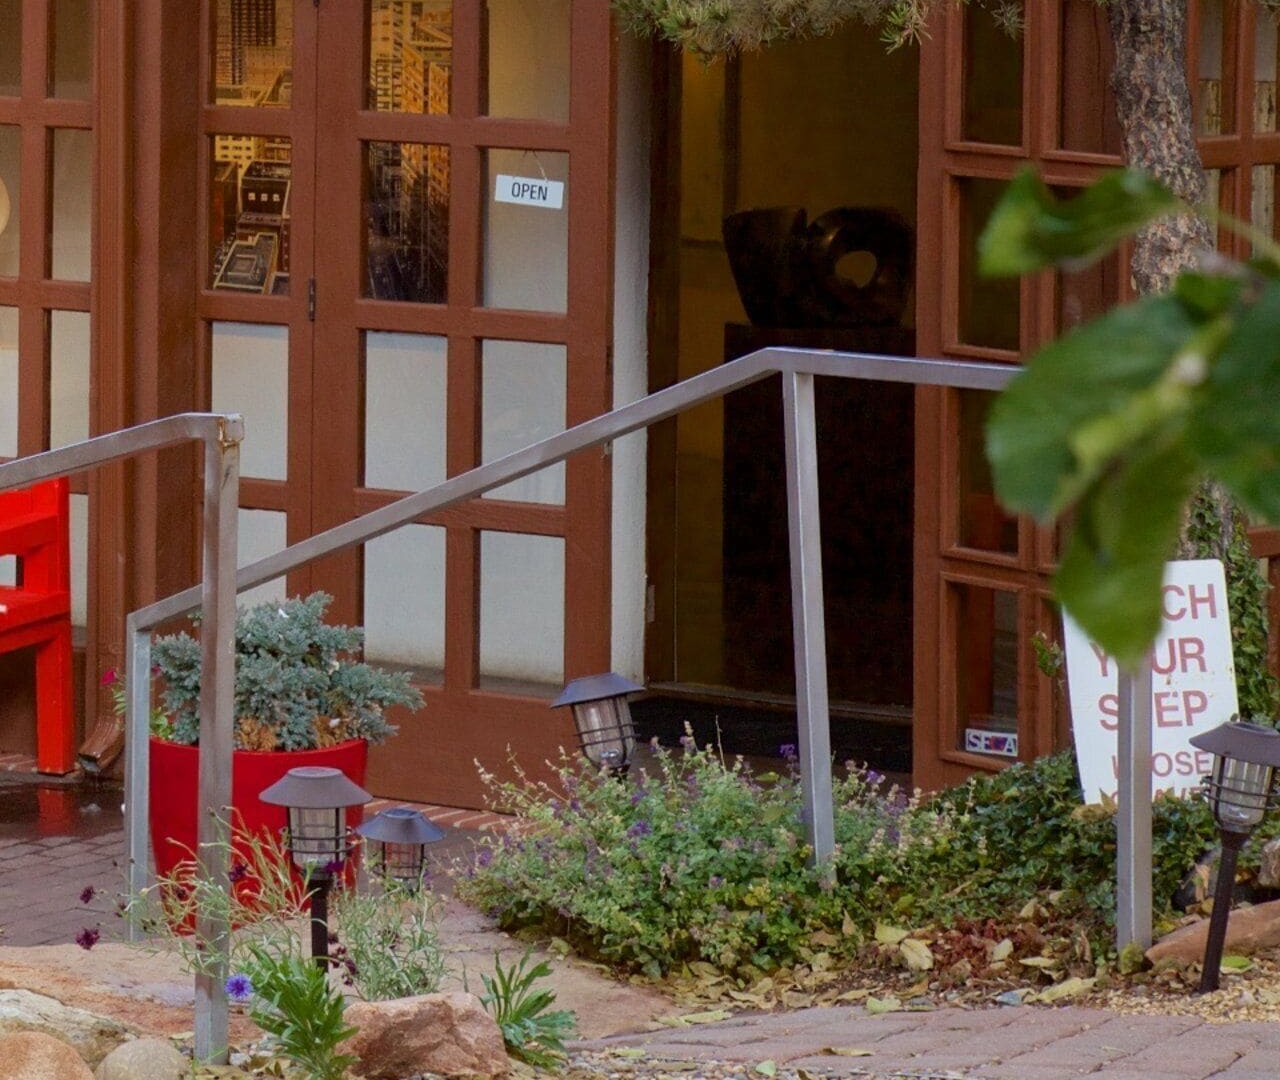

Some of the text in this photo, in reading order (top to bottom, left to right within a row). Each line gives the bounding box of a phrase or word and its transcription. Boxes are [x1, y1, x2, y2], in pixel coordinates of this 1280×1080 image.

[511, 182, 548, 200] OPEN
[1089, 637, 1207, 678] YUR
[1098, 690, 1208, 731] SEP
[1111, 750, 1212, 780] OSE
